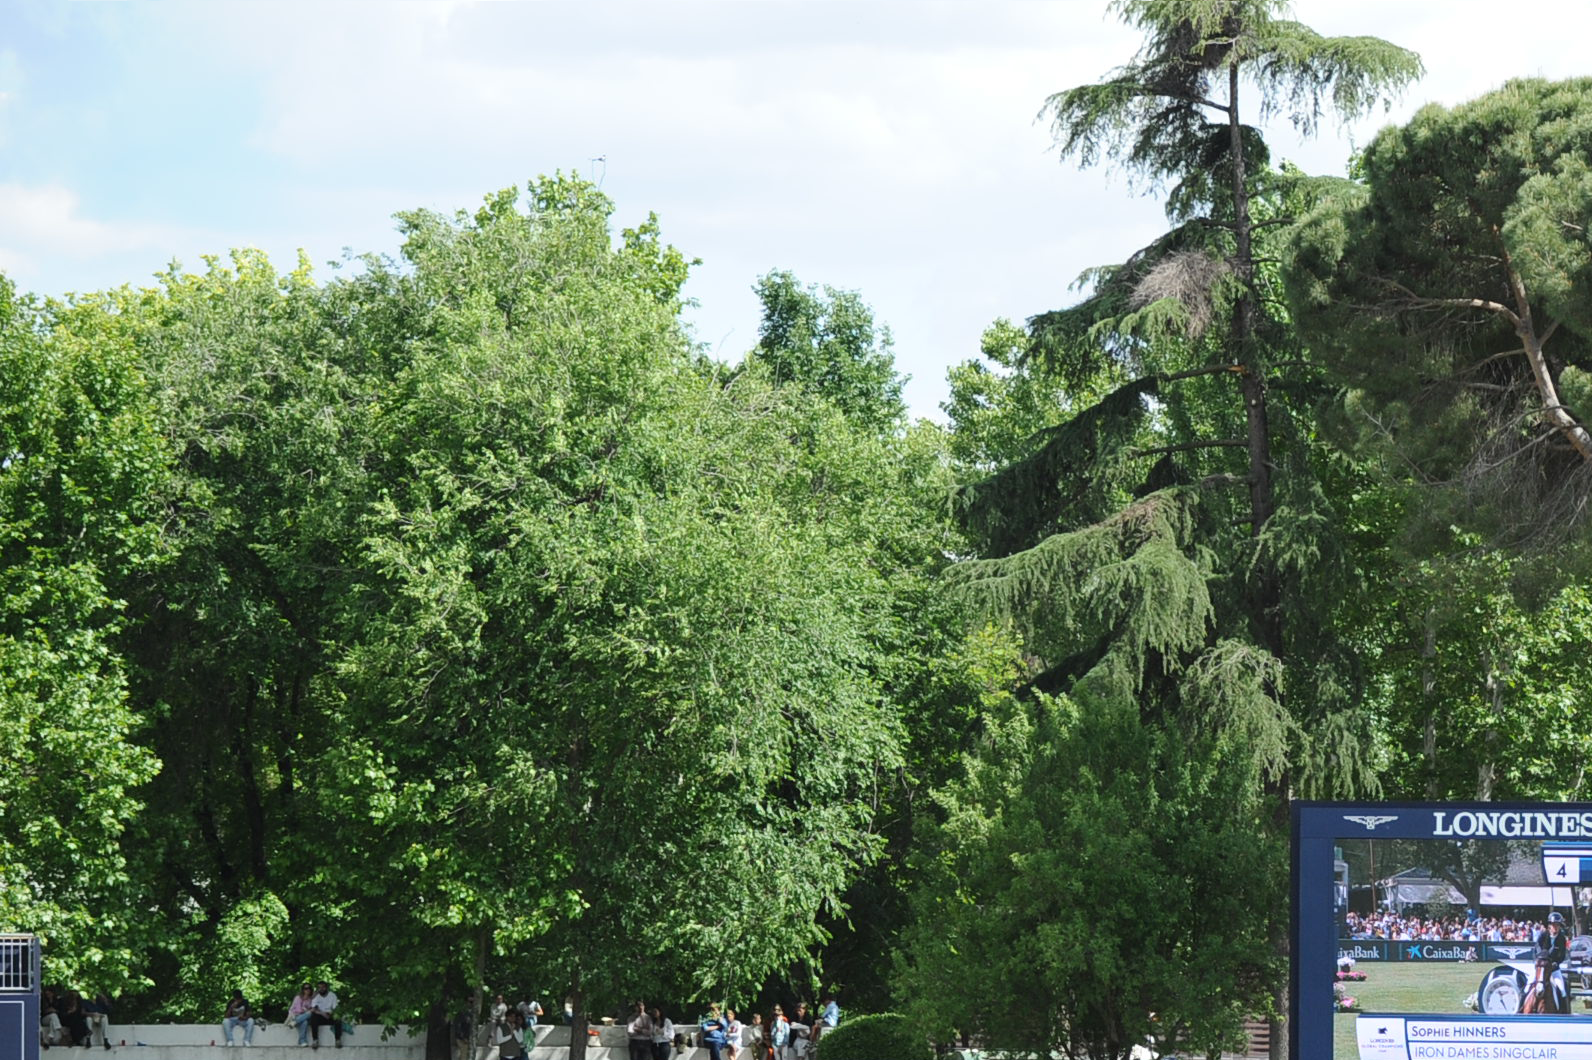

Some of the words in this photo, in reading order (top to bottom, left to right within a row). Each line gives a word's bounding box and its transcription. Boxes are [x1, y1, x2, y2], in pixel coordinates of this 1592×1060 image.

[1556, 862, 1567, 878] 4
[1453, 1026, 1506, 1038] HINNERS
[1414, 1047, 1445, 1058] IRON
[1447, 1047, 1490, 1059] DAMES
[1492, 1047, 1557, 1059] SINGCLAIR
